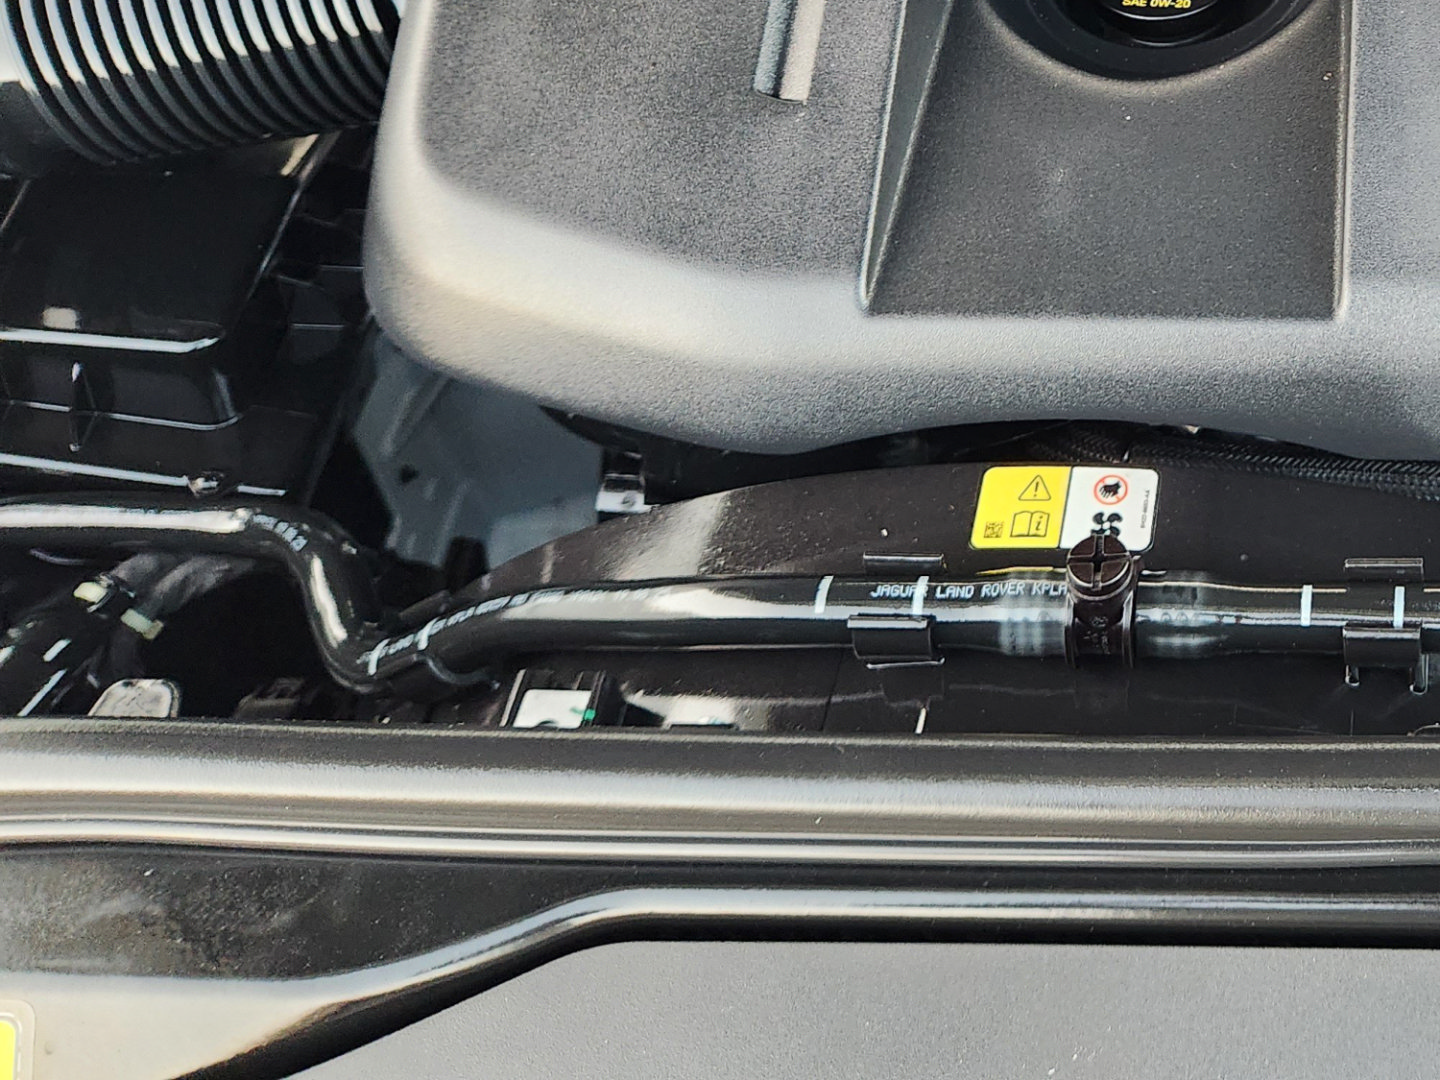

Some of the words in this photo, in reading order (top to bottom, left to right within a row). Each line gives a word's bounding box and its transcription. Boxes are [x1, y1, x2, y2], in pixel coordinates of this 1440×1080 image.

[870, 583, 928, 599] JAGUAR
[935, 584, 975, 599] LAND
[980, 581, 1026, 598] ROVER
